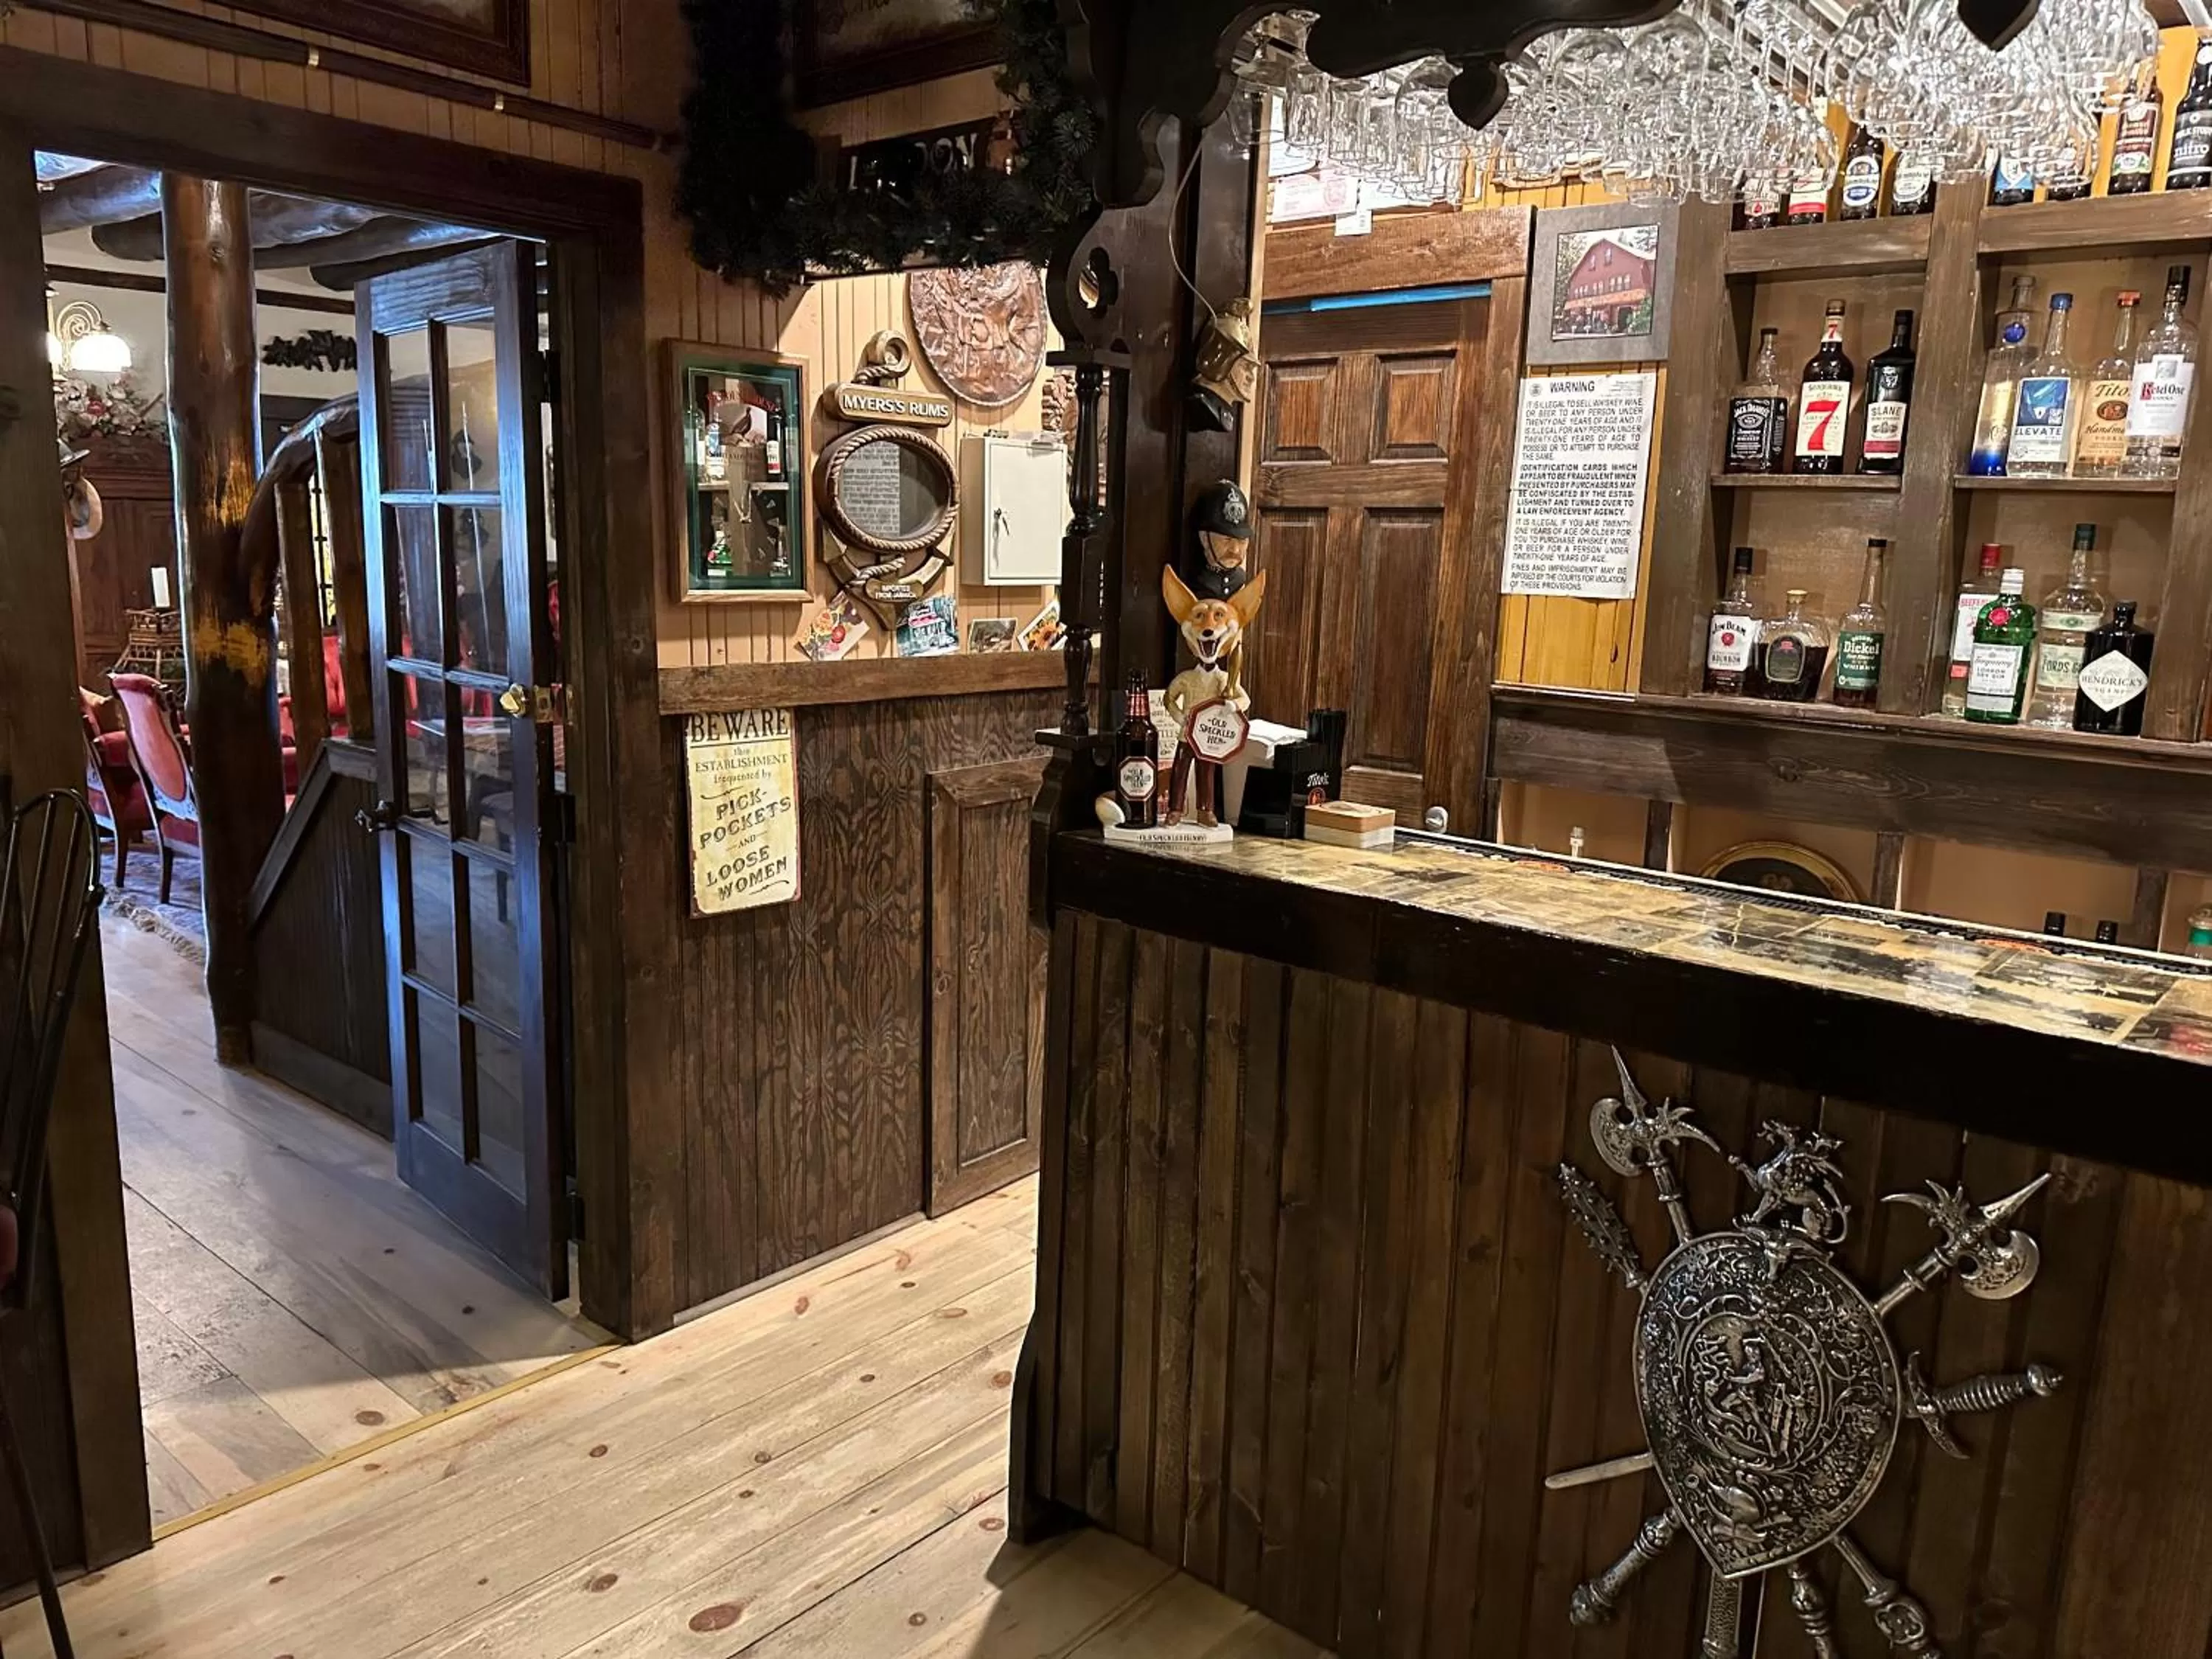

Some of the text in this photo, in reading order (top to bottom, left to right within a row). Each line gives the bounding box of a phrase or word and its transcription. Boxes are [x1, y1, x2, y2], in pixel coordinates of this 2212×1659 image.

[1828, 324, 1838, 339] 7
[1550, 380, 1595, 393] WARNING
[2094, 383, 2131, 397] Tito
[844, 394, 949, 417] MYERS'S RUMS
[1559, 408, 1568, 417] TO
[1588, 408, 1615, 416] PERSON
[1618, 407, 1643, 415] UNDER
[1871, 406, 1902, 417] SLANE
[1589, 425, 1615, 434] PERSON
[1618, 425, 1642, 433] UNDER
[1804, 400, 1842, 451] 7
[2014, 427, 2062, 436] ELEVATE
[1612, 463, 1638, 471] WHICH
[1531, 518, 1558, 526] ILLEGAL
[1604, 546, 1629, 554] UNDER
[1557, 554, 1579, 562] YEARS
[1548, 565, 1598, 573] IMPRISONMENT
[1617, 567, 1627, 575] BE
[1843, 641, 1879, 655] Dickel
[2081, 675, 2143, 686] HENDRICK'S
[691, 708, 789, 742] BEWARE
[695, 754, 787, 773] ESTABLISHMENT
[761, 768, 772, 781] by
[700, 796, 792, 849] POCKETS
[738, 834, 756, 849] AND
[706, 845, 771, 887] LOOSE
[717, 855, 787, 900] WOMEN
